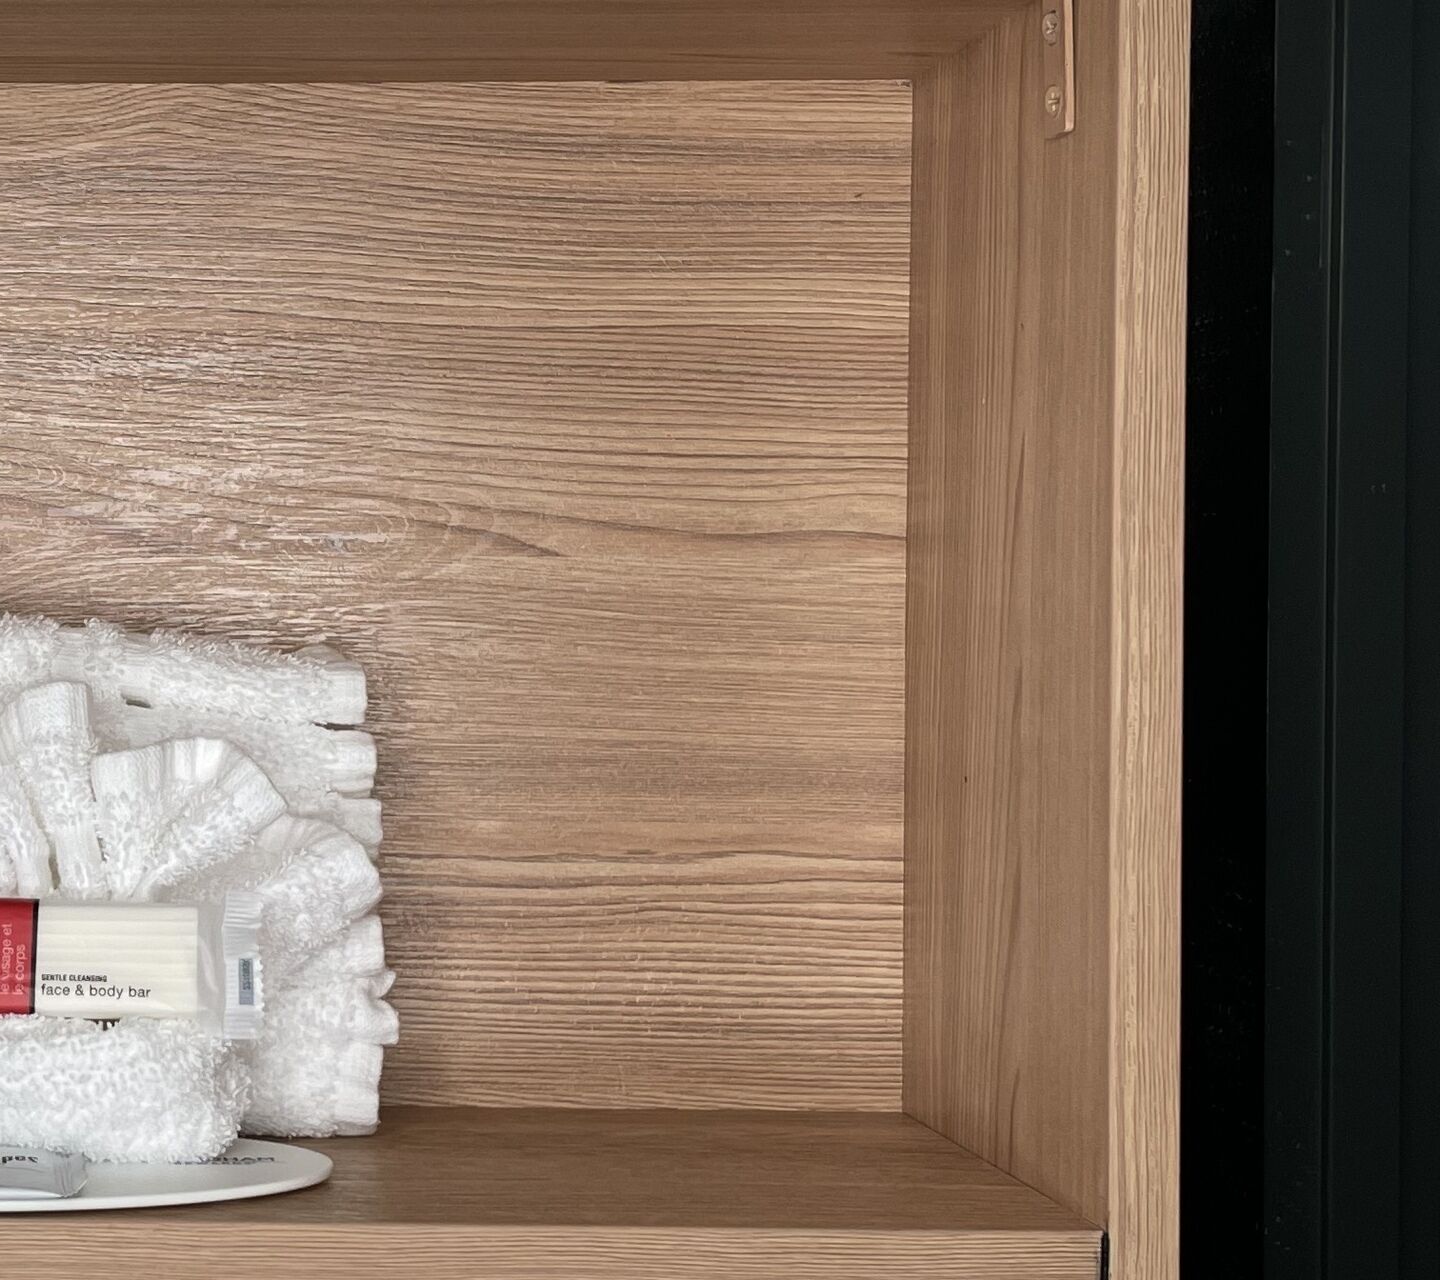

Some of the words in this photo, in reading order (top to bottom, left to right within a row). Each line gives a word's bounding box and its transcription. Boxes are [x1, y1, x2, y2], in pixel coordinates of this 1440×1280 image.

[1, 924, 13, 936] et
[13, 943, 28, 981] corps
[41, 973, 67, 982] GENTLE
[68, 974, 108, 983] CLEANSING
[12, 983, 24, 995] le
[41, 983, 71, 996] face
[74, 984, 85, 996] &
[89, 984, 124, 1000] body
[128, 985, 152, 998] bar
